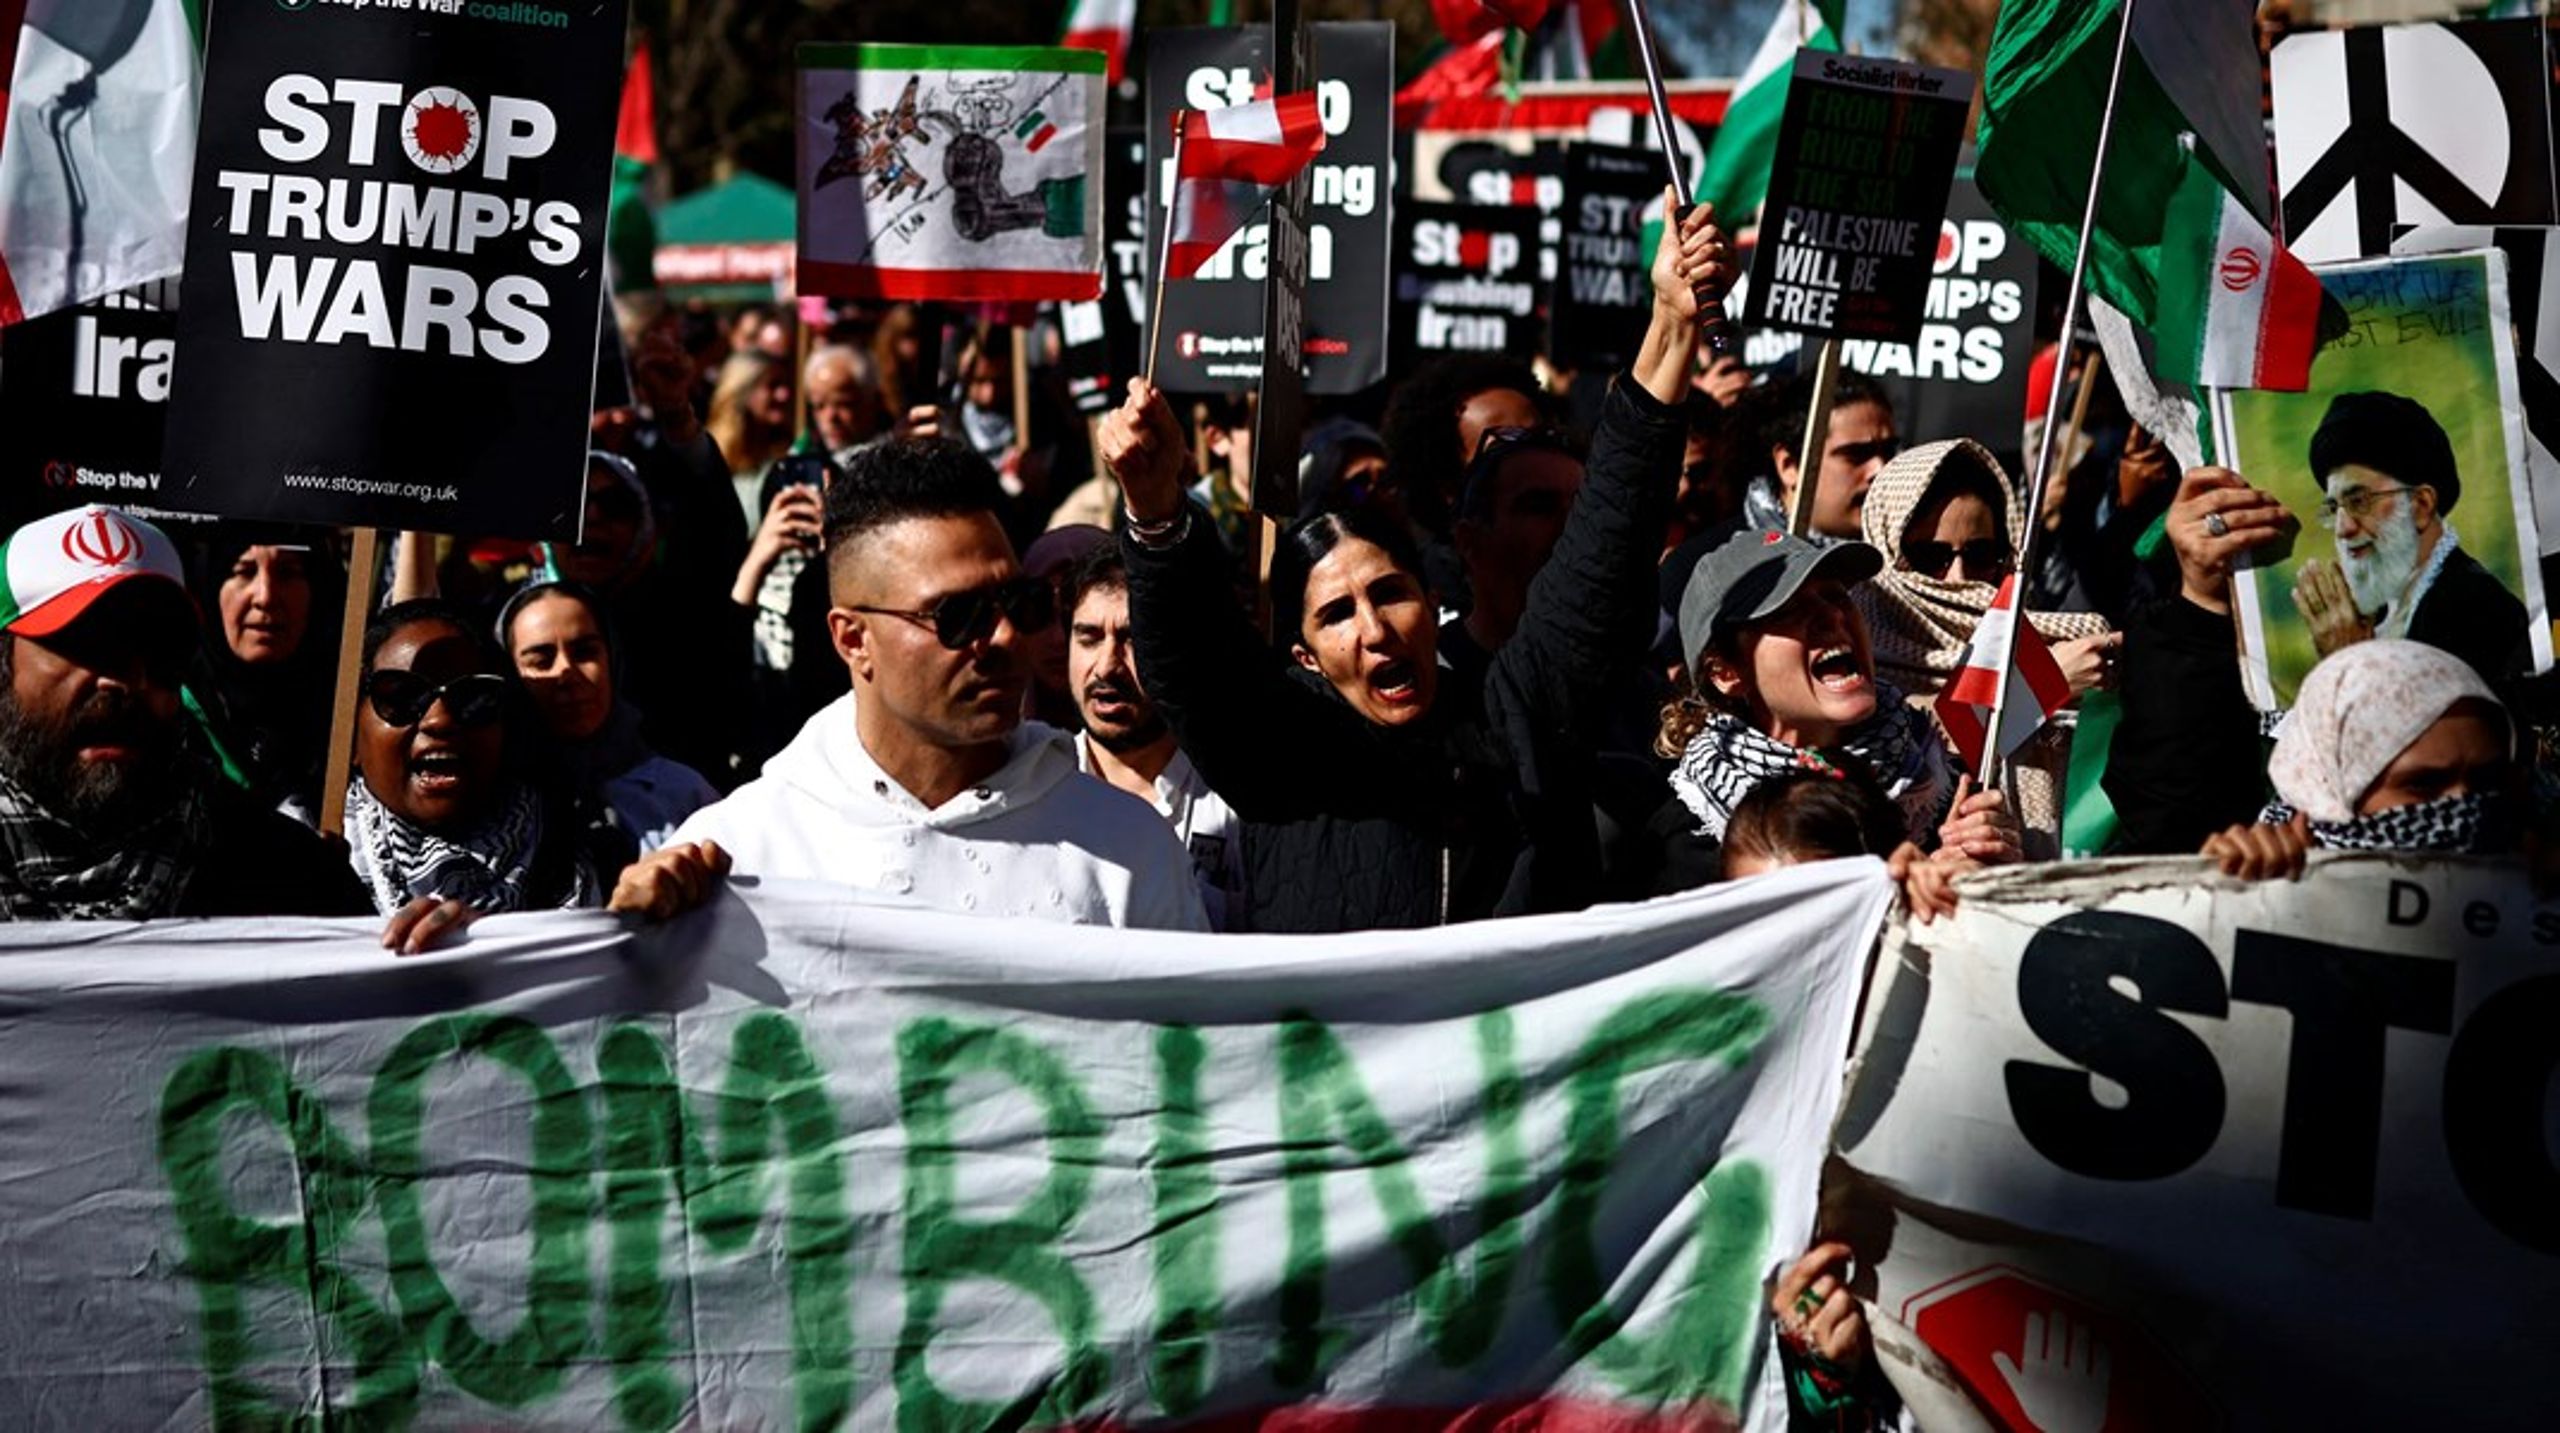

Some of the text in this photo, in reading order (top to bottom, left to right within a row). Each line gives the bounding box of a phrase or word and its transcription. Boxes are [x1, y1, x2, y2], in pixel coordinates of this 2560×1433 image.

[467, 2, 568, 28] coalition
[258, 73, 557, 181] STOP
[1797, 127, 1884, 174] RIVER
[217, 170, 582, 267] TRUMP'S
[1780, 205, 1920, 257] PALESTINE
[1773, 243, 1883, 294] WILL BE
[231, 251, 550, 364] WARS
[1416, 303, 1506, 349] Iran
[1763, 283, 1840, 330] FREE
[2395, 306, 2485, 346] EVIL
[76, 467, 115, 490] Stop
[119, 471, 147, 489] the
[284, 474, 458, 503] www.stopwar.org.uk
[158, 984, 1773, 1433] BOMBING
